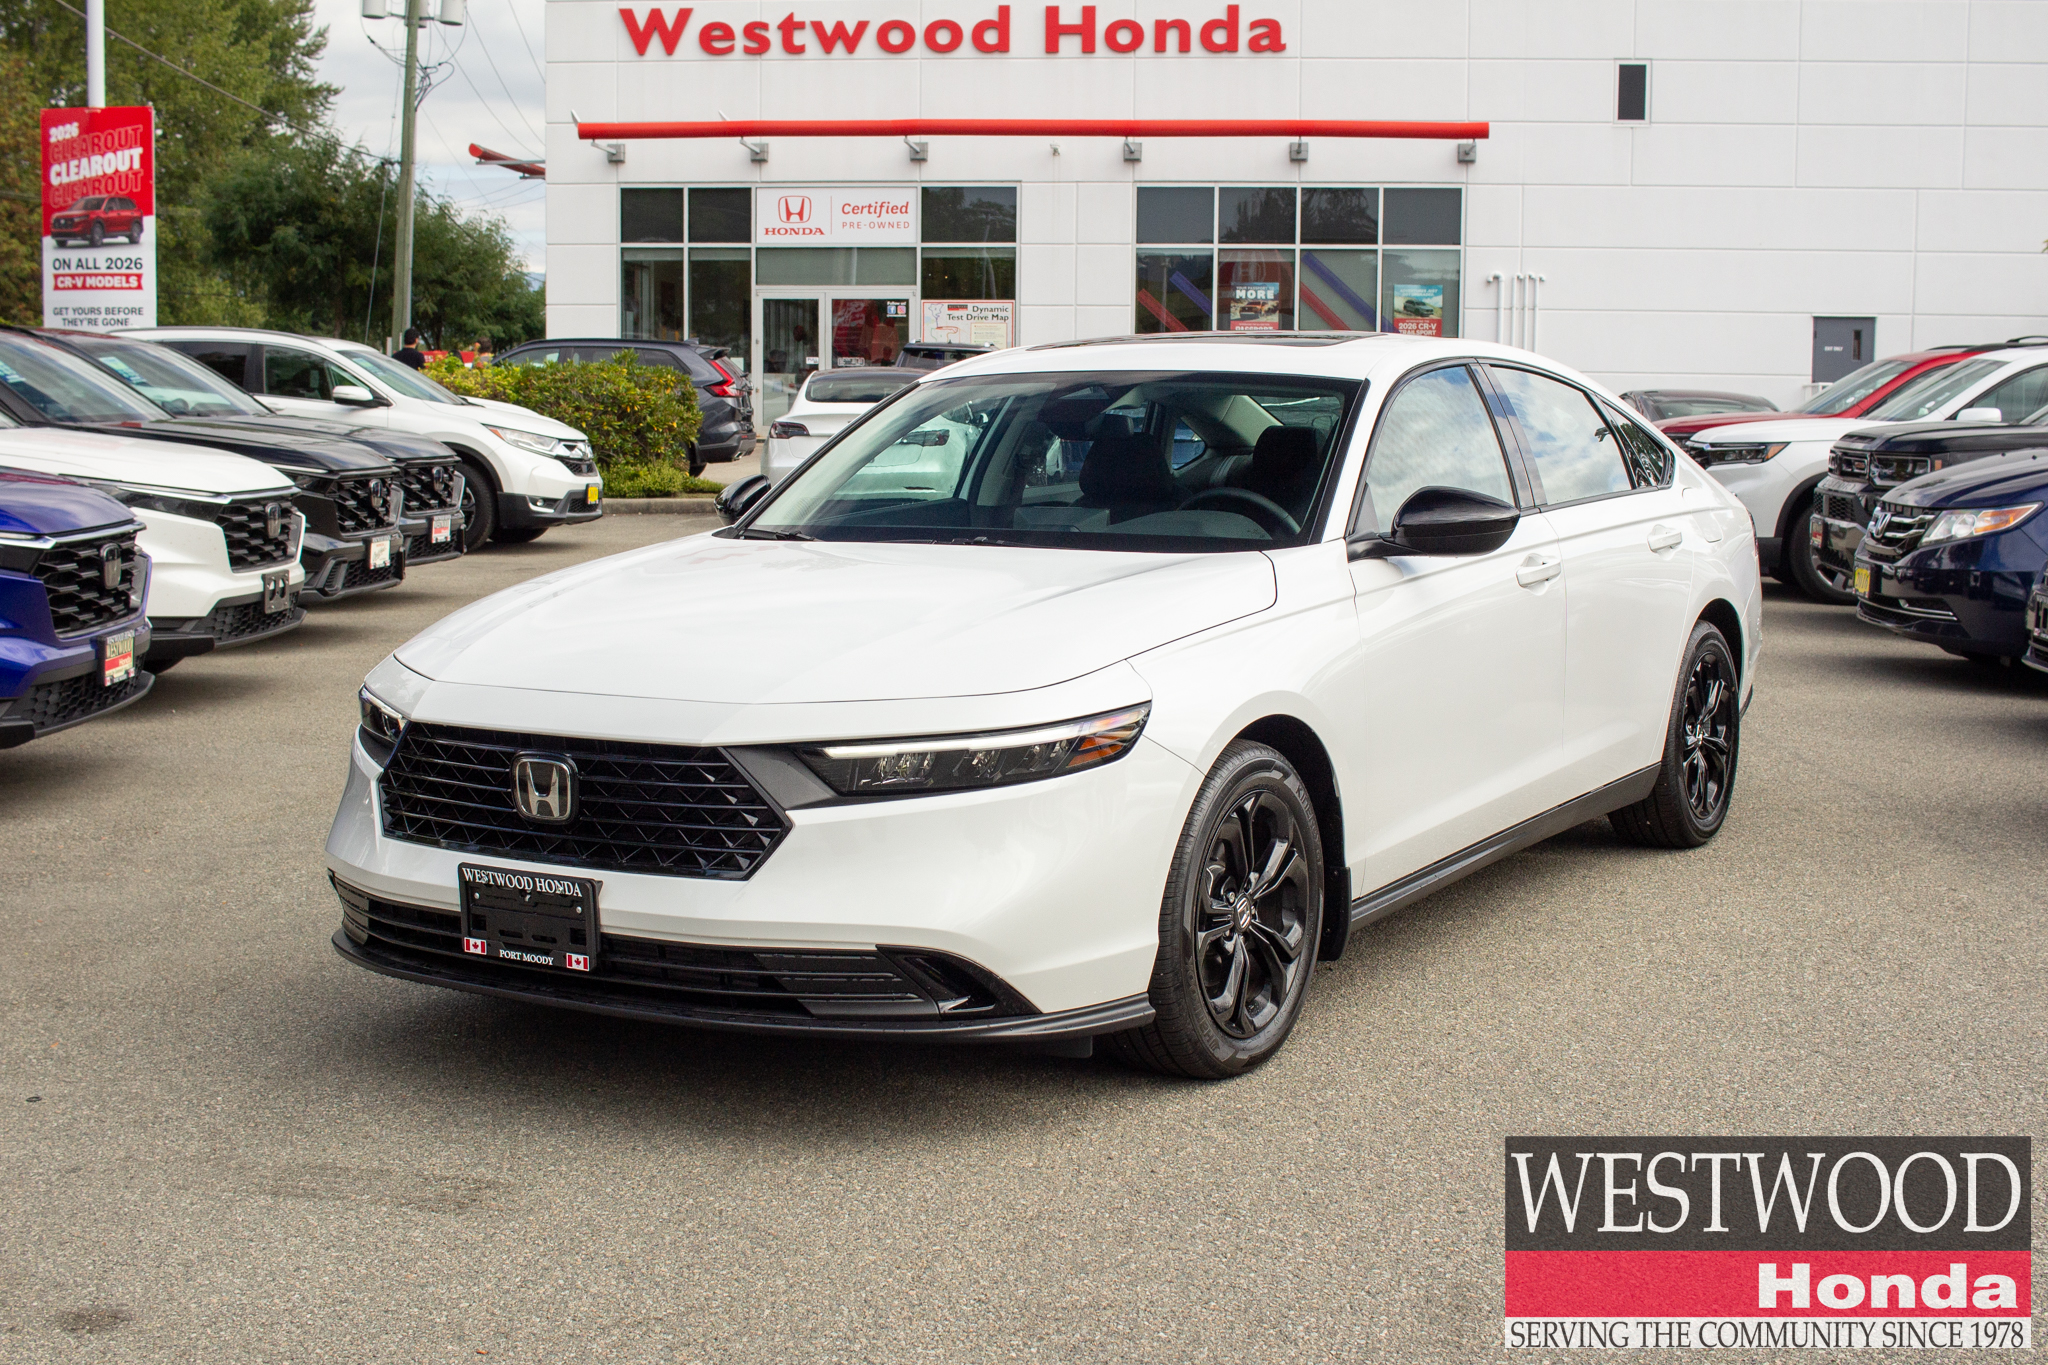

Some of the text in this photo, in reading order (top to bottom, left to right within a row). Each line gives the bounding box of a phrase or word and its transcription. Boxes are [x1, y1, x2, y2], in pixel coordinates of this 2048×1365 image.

[618, 4, 1286, 56] Westwood Honda
[49, 122, 79, 143] 2026
[49, 147, 143, 186] CLEAROUT
[841, 201, 910, 218] Certified
[764, 227, 825, 236] HONDA
[842, 221, 910, 229] PRE-OWNED
[53, 257, 143, 270] ON ALL 2026
[57, 275, 138, 288] CR-V MODELS
[1235, 290, 1275, 299] MORE
[53, 306, 144, 315] GET YOURS BEFORE
[972, 305, 1009, 313] Dynamic
[947, 313, 1009, 323] Test Drive Map
[1398, 322, 1437, 330] 2026 CR-V
[462, 867, 582, 897] WESTWOOD HONDA
[500, 949, 554, 965] PORT MOODY
